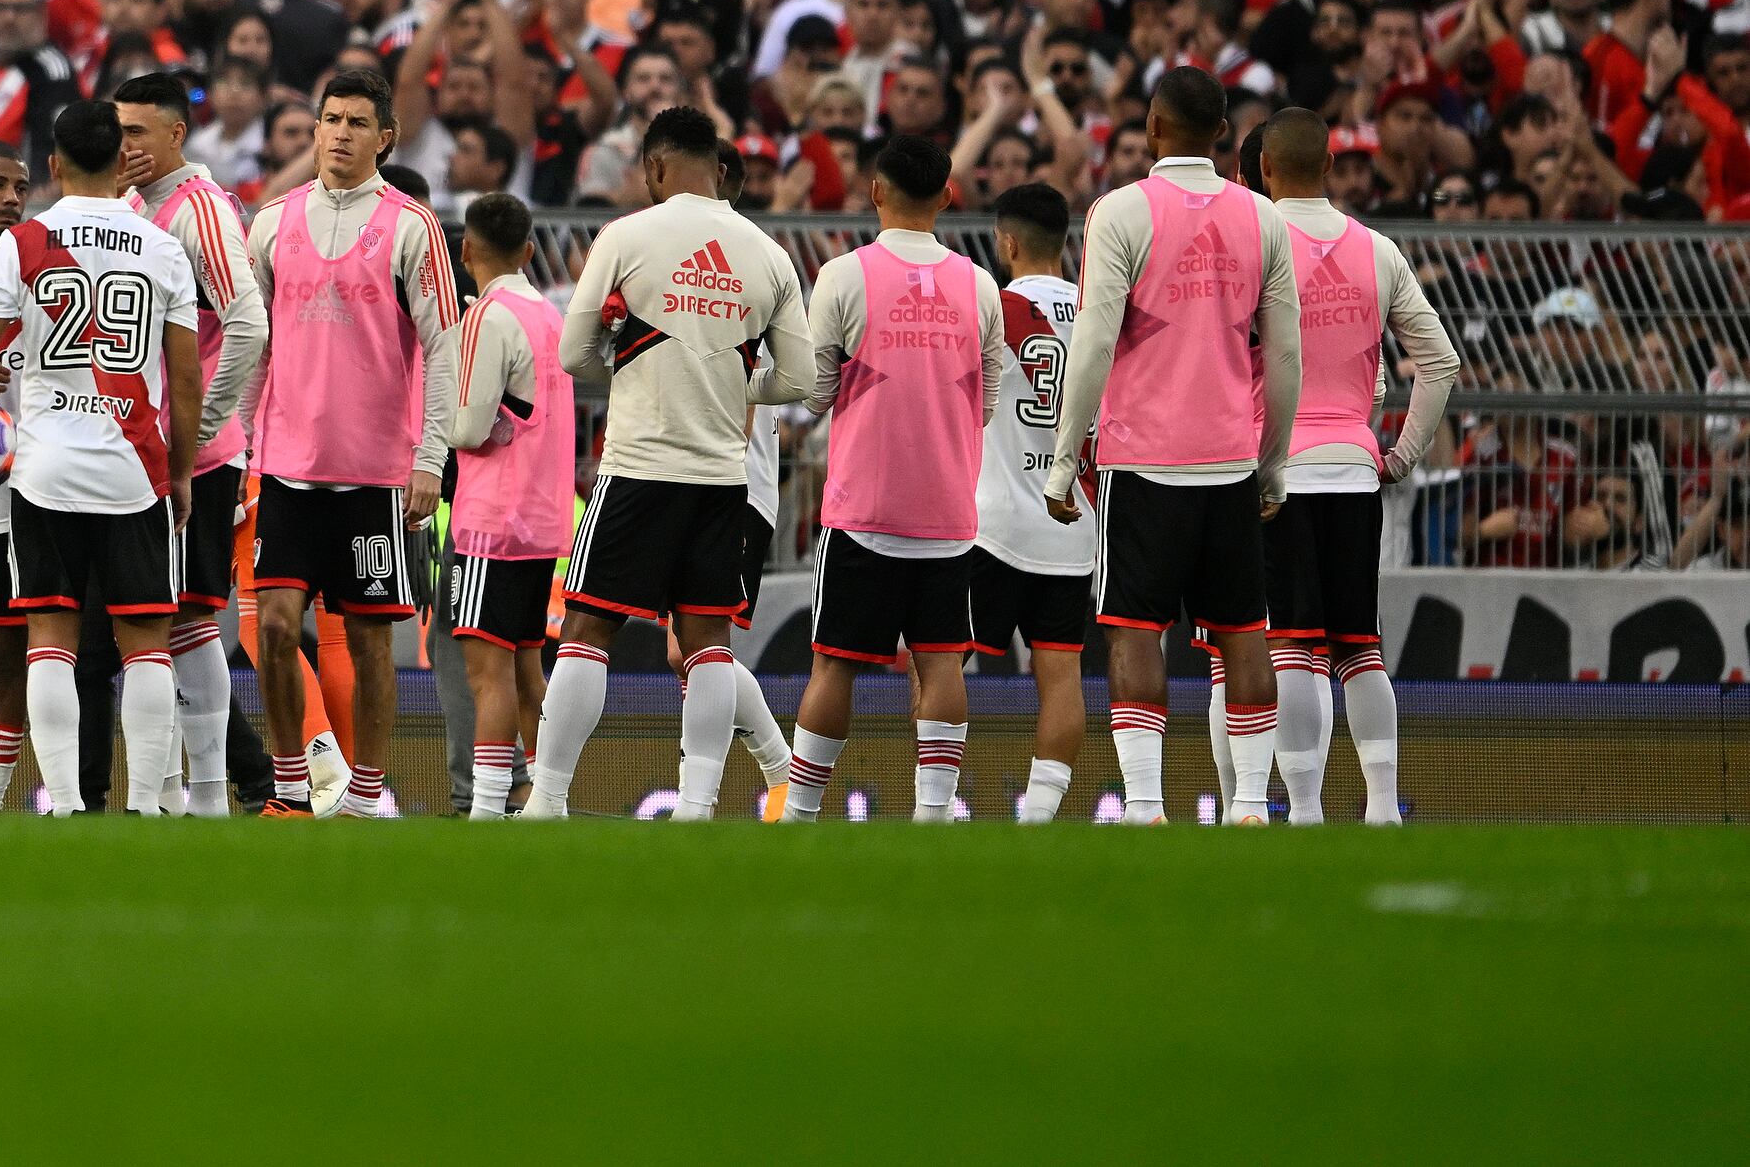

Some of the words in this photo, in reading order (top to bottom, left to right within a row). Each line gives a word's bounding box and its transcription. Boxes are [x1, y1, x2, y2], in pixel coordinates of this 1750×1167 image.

[47, 226, 142, 256] ALIENDRO
[672, 269, 743, 293] adidas
[1166, 279, 1245, 303] DIRETV
[663, 293, 751, 321] DIRECTV
[889, 305, 959, 325] adidas
[1053, 302, 1077, 323] GO
[1302, 306, 1373, 329] IRECTV
[34, 266, 154, 374] 29
[879, 330, 967, 353] DIRECTV
[50, 390, 133, 419] DIRECTV
[352, 535, 393, 579] 10
